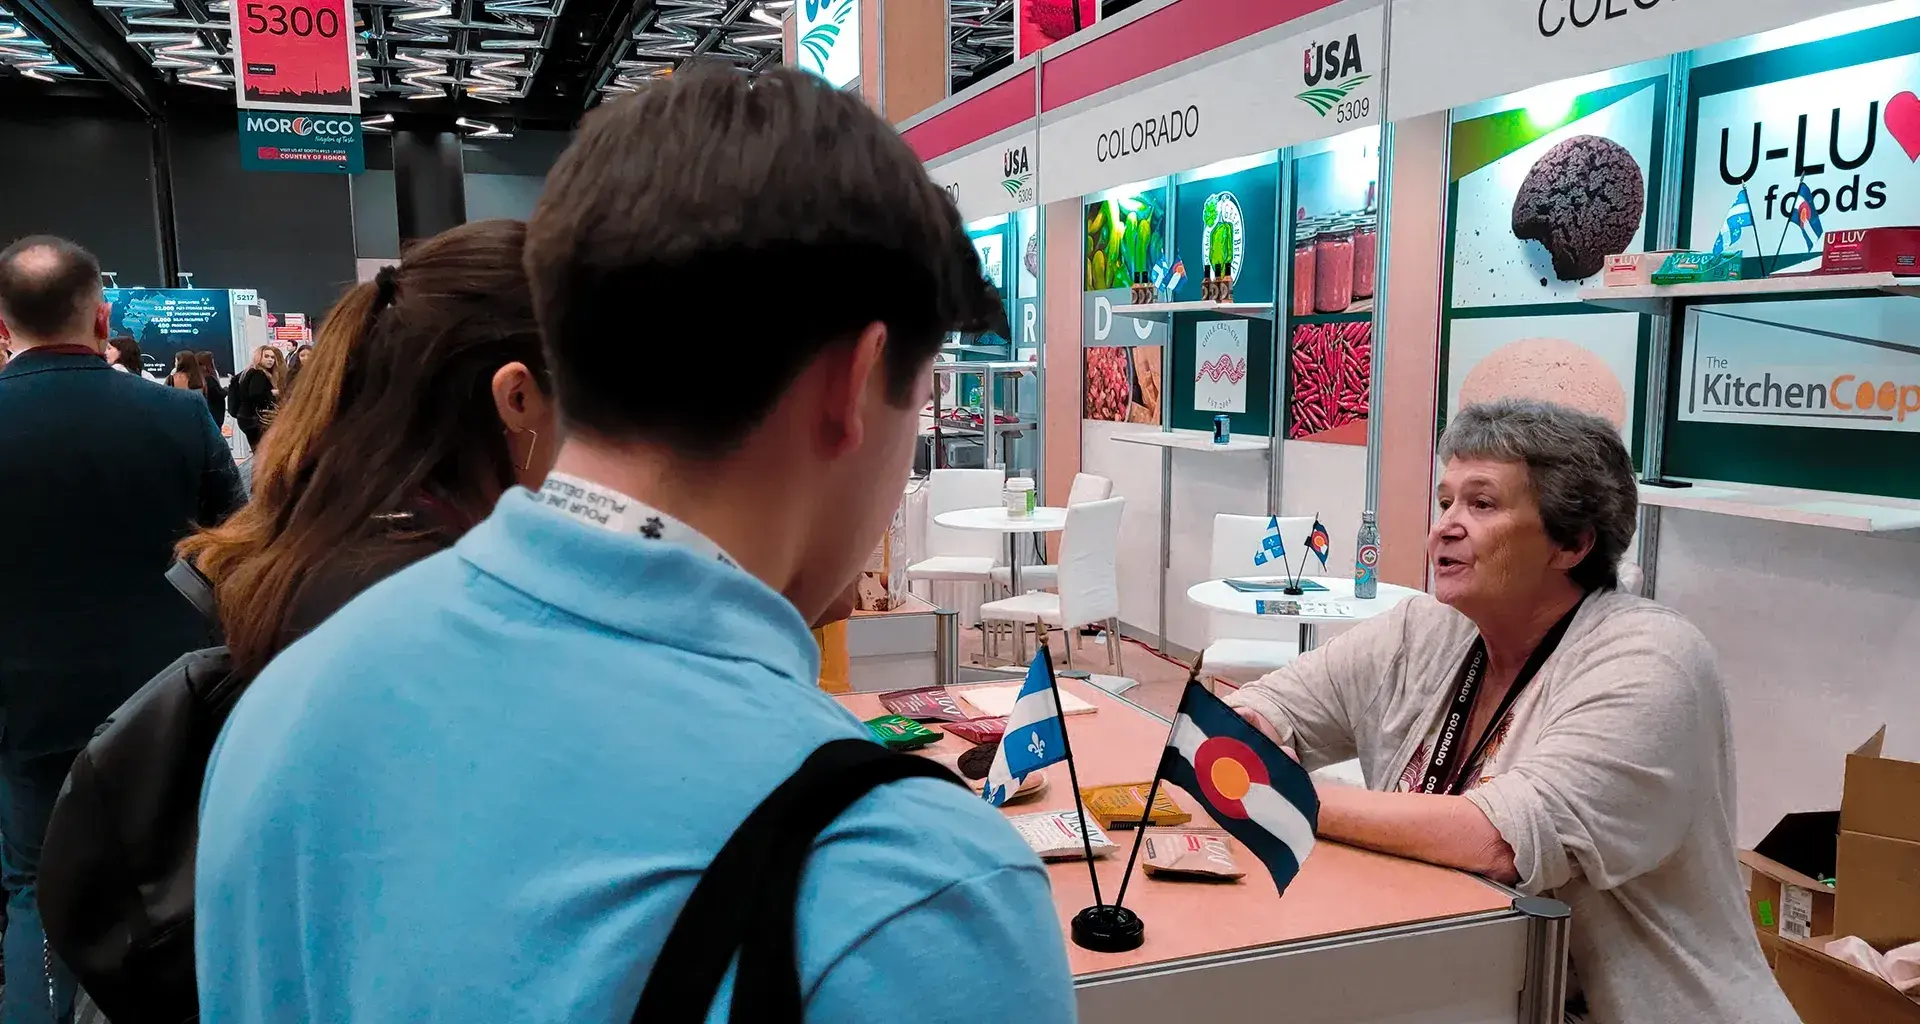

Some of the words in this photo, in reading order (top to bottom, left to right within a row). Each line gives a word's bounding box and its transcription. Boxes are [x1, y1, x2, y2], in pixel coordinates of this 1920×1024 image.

[247, 3, 339, 38] 5300
[1304, 34, 1362, 87] USA
[247, 116, 354, 136] MOROCCO
[1337, 97, 1369, 123] 5309
[1097, 105, 1199, 162] COLORADO
[1004, 146, 1029, 178] USA
[1018, 188, 1033, 204] 5309
[1764, 174, 1887, 220] foods
[1707, 356, 1728, 369] The
[569, 502, 610, 525] POUR
[587, 492, 627, 514] PLUS
[1459, 651, 1483, 703] COLORADO
[1435, 712, 1460, 766] COLORADO
